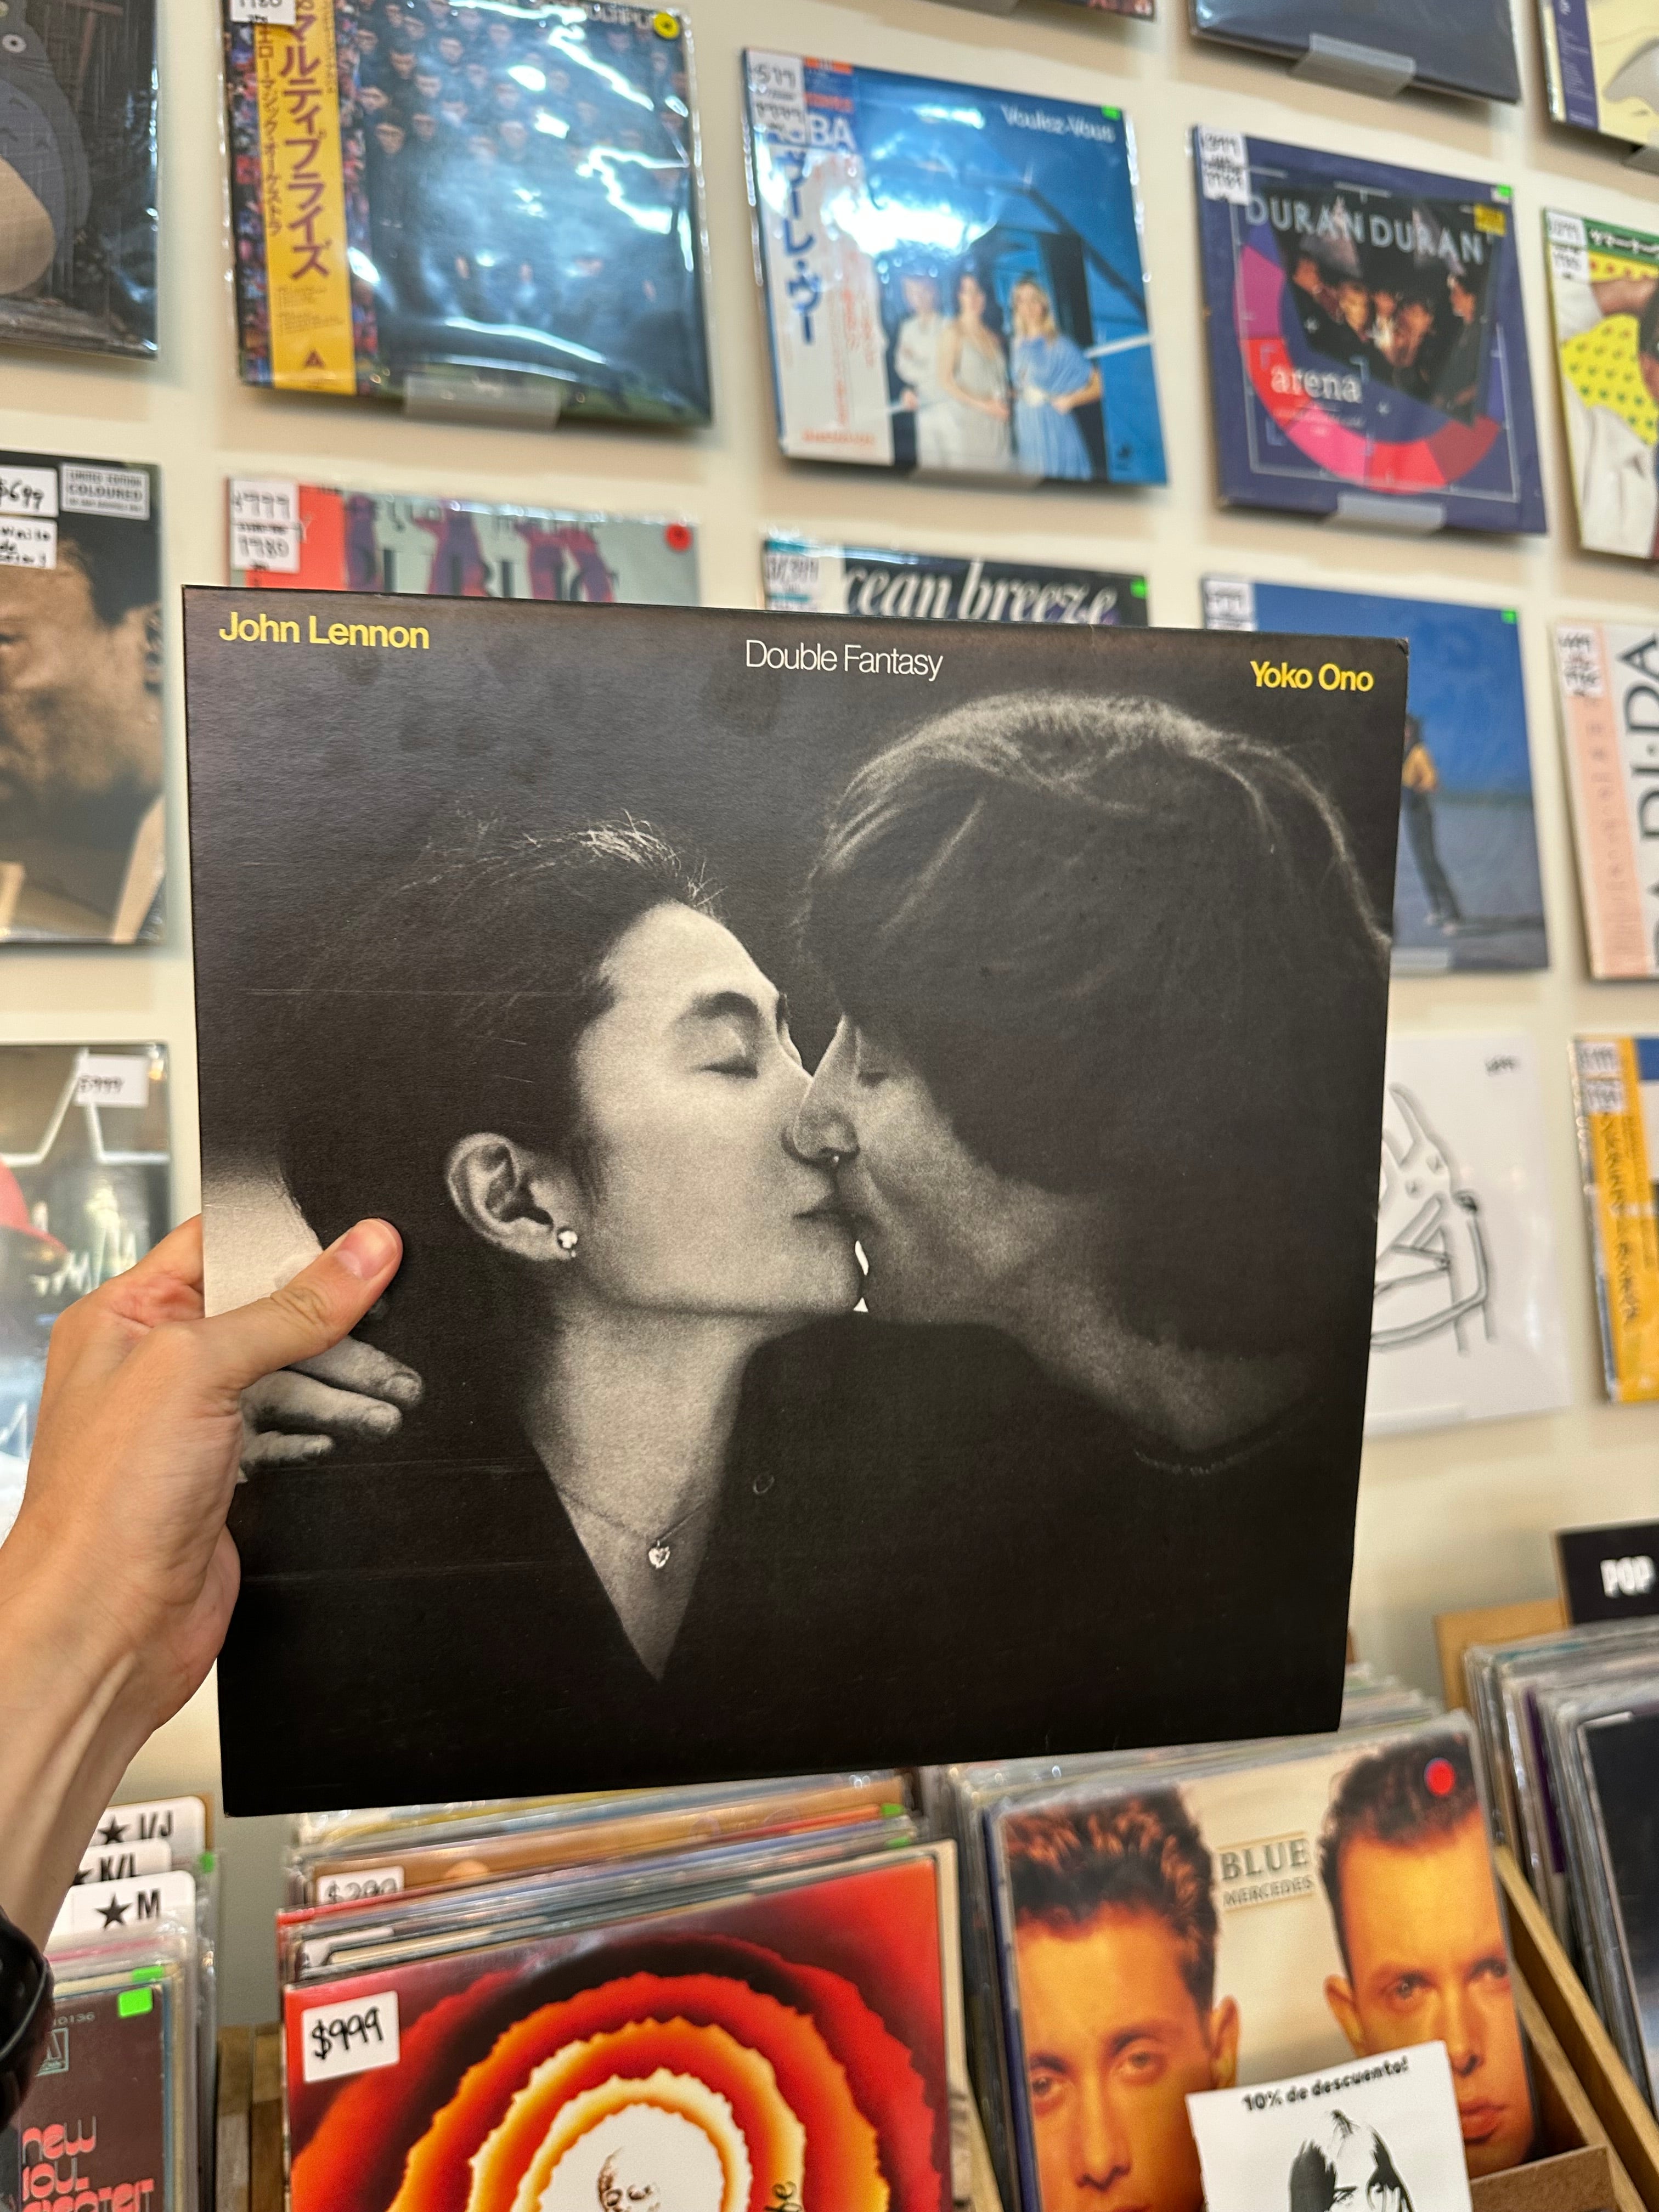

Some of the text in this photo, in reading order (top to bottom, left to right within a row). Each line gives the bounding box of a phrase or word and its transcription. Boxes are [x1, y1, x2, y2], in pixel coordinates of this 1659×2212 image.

[1245, 194, 1483, 265] DURAN DURAN
[1270, 364, 1363, 404] arena
[844, 565, 953, 616] cean
[957, 557, 1118, 624] breeze
[219, 611, 430, 650] John Lennon
[746, 639, 944, 682] Double Fantasy
[1250, 660, 1374, 692] Yoko Ono
[1600, 1555, 1656, 1598] POP
[1221, 1839, 1309, 1881] BLUE
[137, 1888, 162, 1920] M
[1224, 1875, 1314, 1906] MERCEDES
[310, 2006, 383, 2061] $999
[1242, 2056, 1409, 2112] 10% de descuento!
